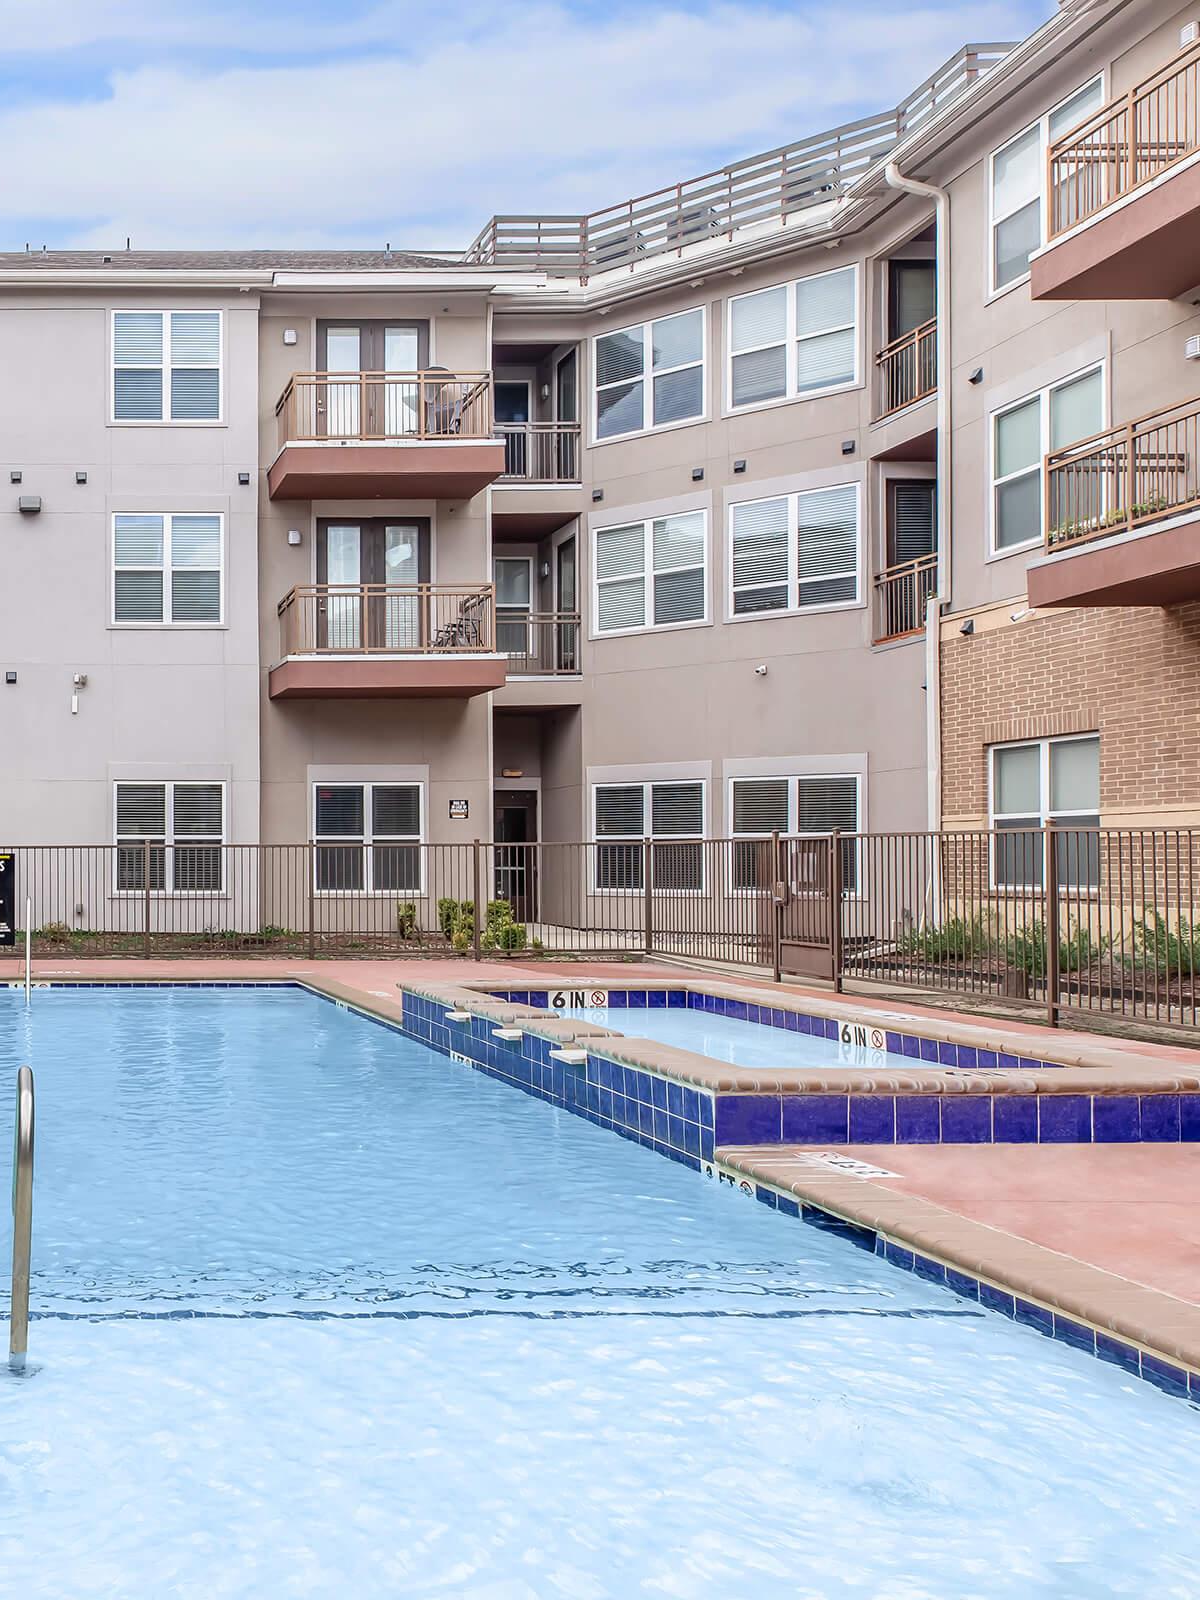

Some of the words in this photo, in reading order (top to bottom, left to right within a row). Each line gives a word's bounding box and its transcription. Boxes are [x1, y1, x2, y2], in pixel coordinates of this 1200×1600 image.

[552, 992, 565, 1008] 6
[841, 1024, 851, 1043] 6
[855, 1026, 866, 1047] IN
